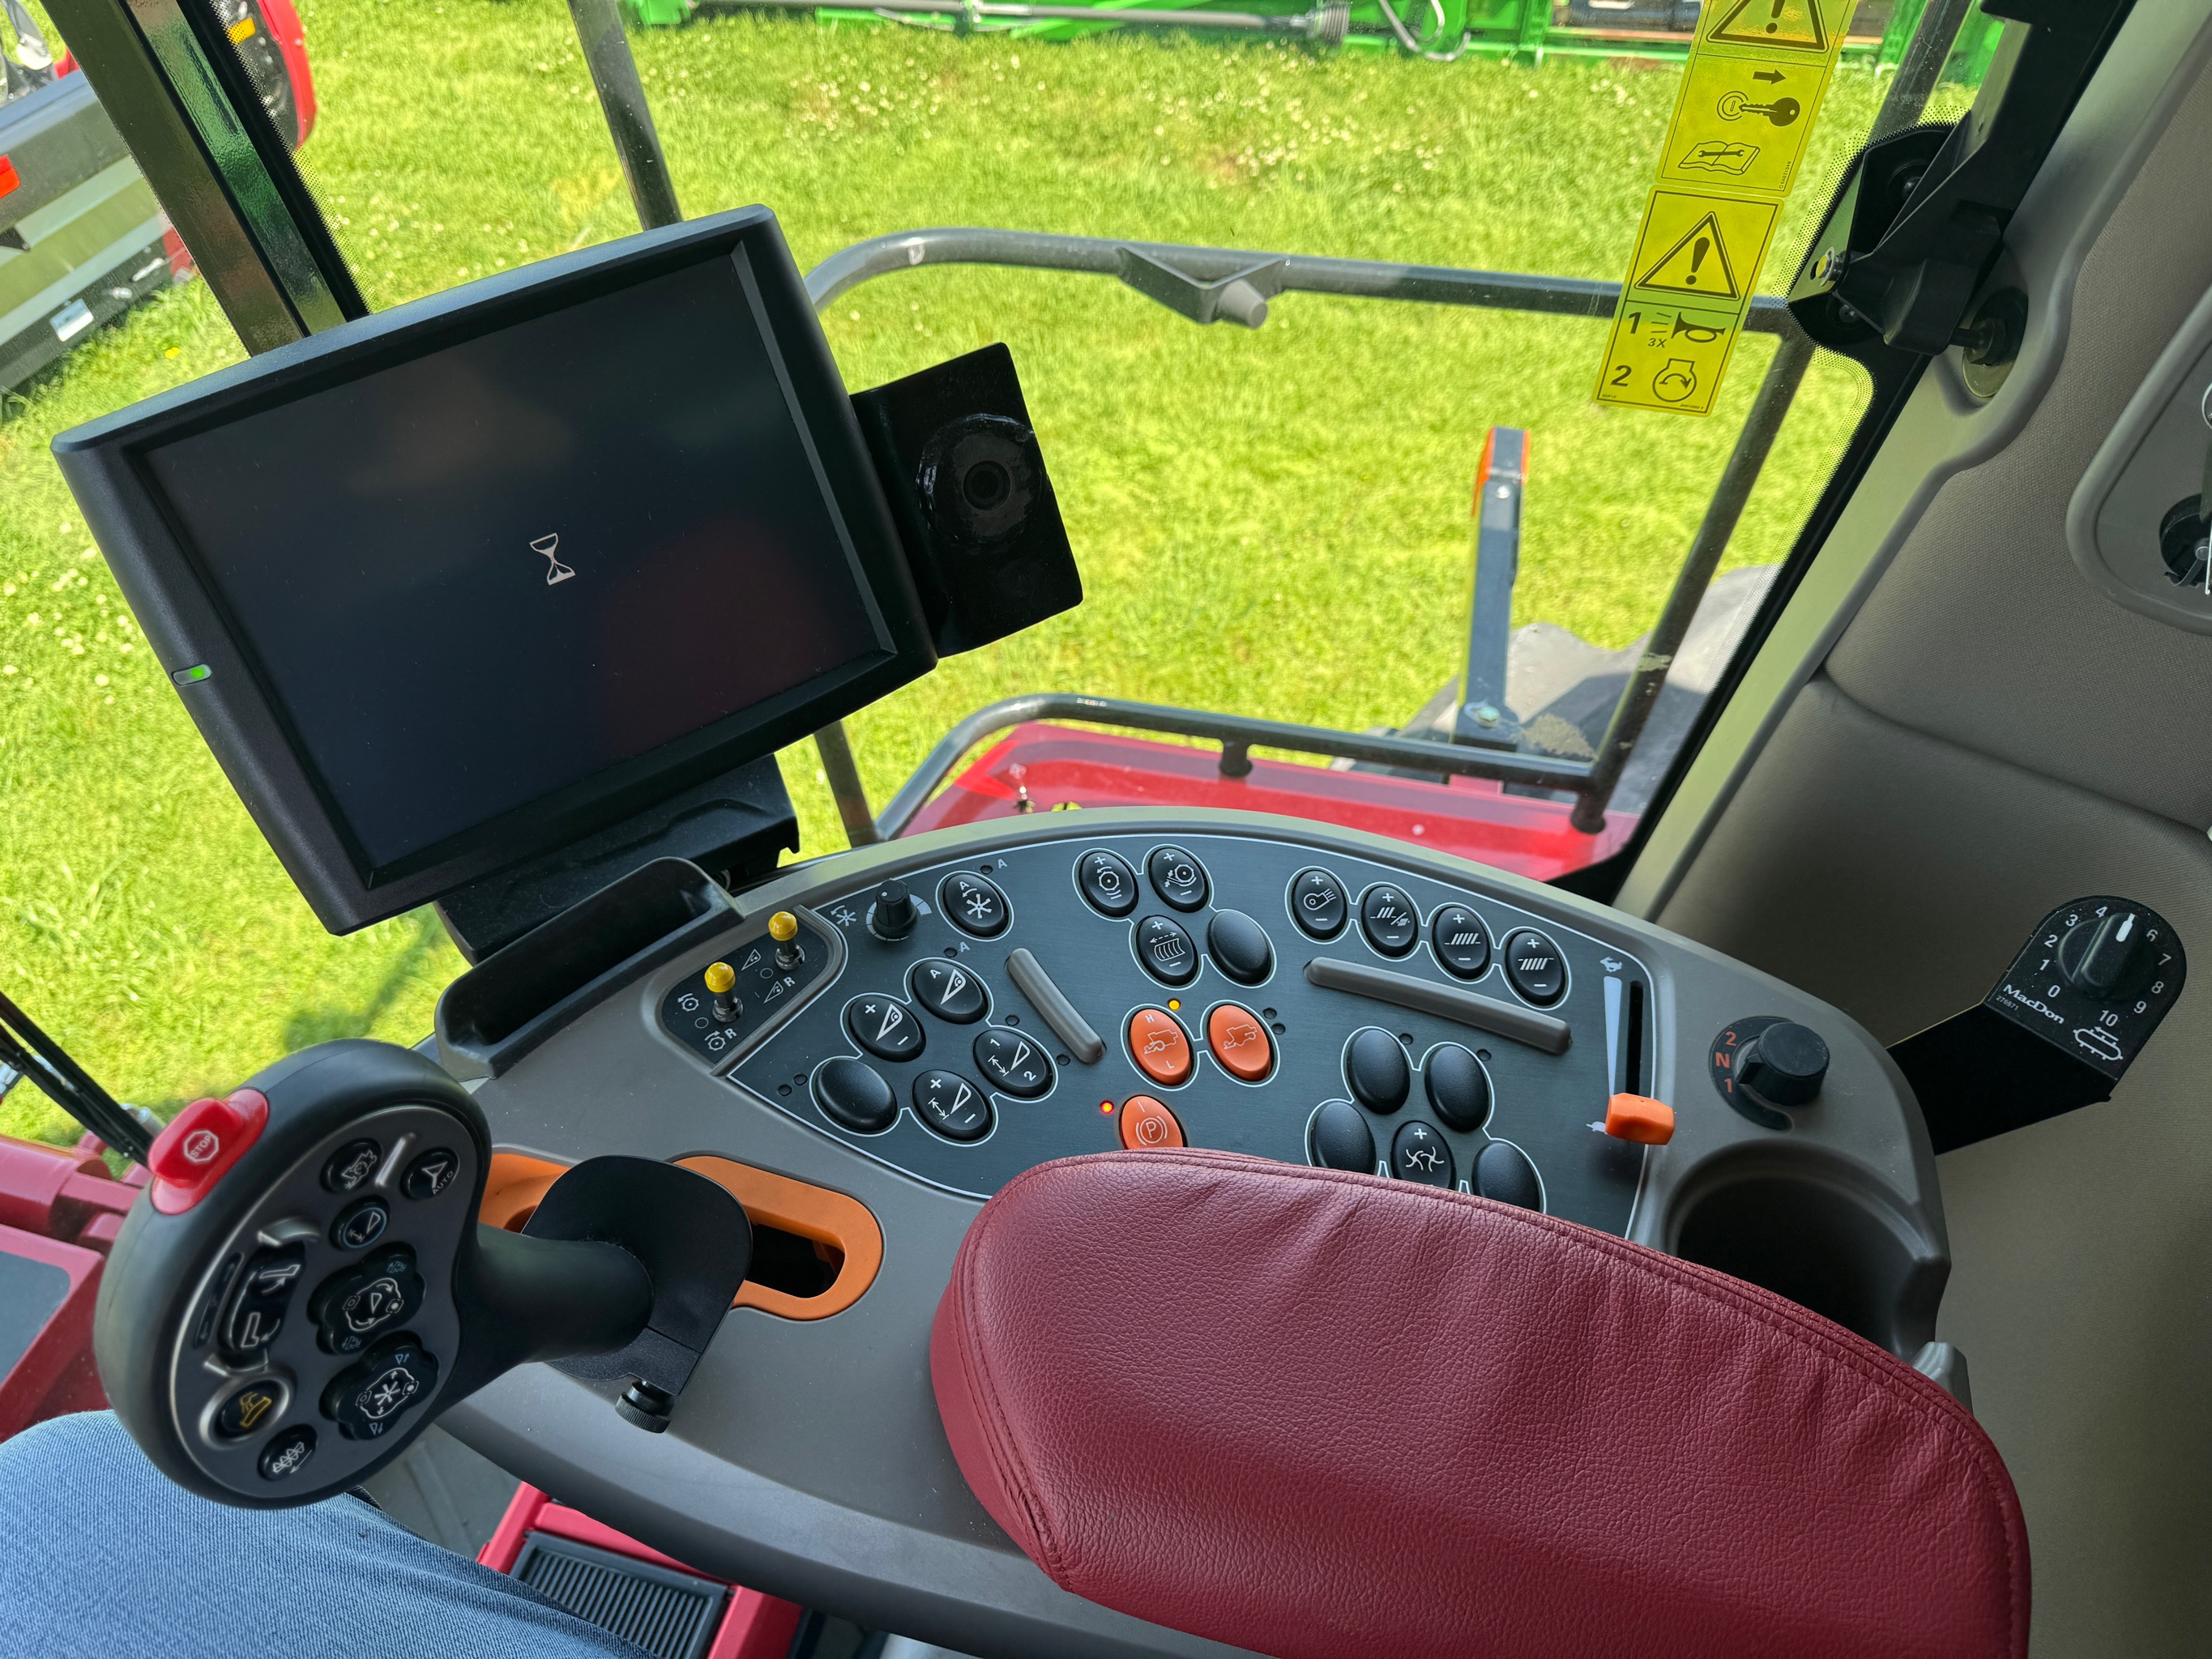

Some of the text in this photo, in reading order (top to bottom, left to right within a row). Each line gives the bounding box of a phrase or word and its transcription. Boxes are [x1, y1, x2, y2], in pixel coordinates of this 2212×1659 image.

[1628, 311, 1642, 335] 1
[1647, 337, 1667, 348] 3X
[1610, 365, 1632, 386] 2
[997, 859, 1008, 869] A
[959, 881, 970, 890] A
[2095, 906, 2108, 918] 4
[2065, 914, 2078, 927] 3
[2043, 934, 2058, 948] 2
[2146, 929, 2159, 942] 6
[959, 941, 970, 953] A
[2039, 959, 2050, 971] 1
[2158, 953, 2172, 966] 7
[929, 969, 942, 979] A
[783, 976, 796, 987] R
[2150, 981, 2164, 994] 8
[2048, 985, 2060, 998] 0
[2003, 984, 2065, 1024] MacDon
[2133, 1000, 2147, 1014] 9
[1144, 1013, 1155, 1024] H
[2099, 1009, 2119, 1027] 10
[724, 1028, 737, 1039] R
[1726, 1031, 1736, 1046] 2
[989, 1038, 1001, 1047] 1
[1165, 1060, 1175, 1070] L
[1715, 1051, 1730, 1068] N
[1023, 1070, 1037, 1081] 2
[1724, 1078, 1732, 1093] 1
[1145, 1120, 1157, 1139] P
[190, 1135, 211, 1158] STOP
[433, 1171, 453, 1195] AUTO
